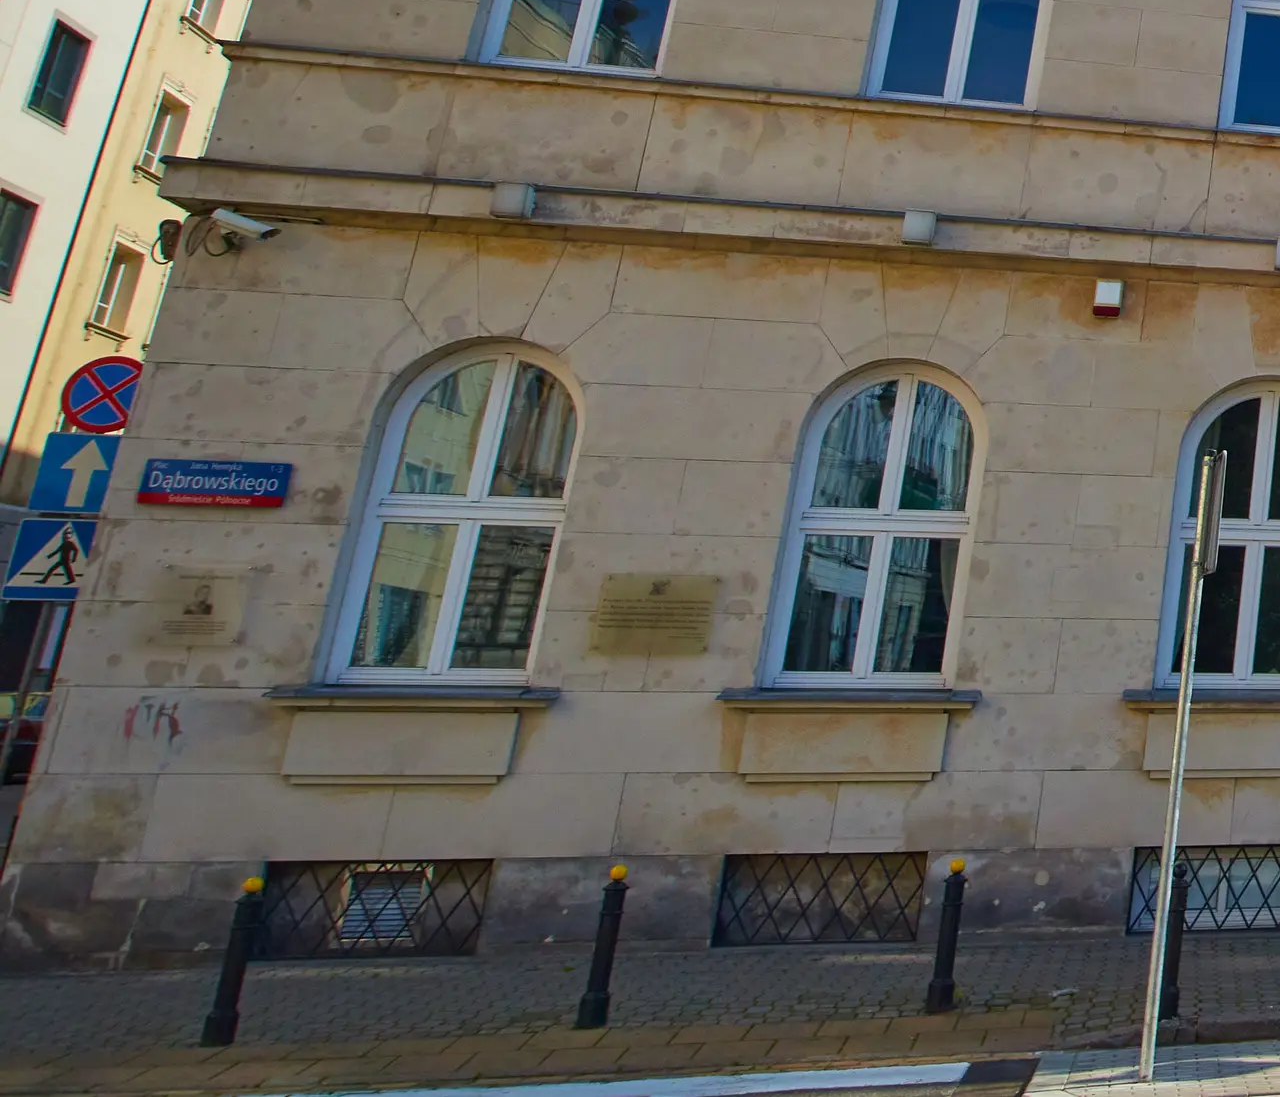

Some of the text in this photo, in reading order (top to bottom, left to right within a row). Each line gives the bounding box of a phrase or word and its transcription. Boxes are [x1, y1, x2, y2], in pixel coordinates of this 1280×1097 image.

[152, 461, 169, 469] Plac
[211, 462, 243, 472] Henryka
[149, 470, 278, 495] Dąbrowskiego
